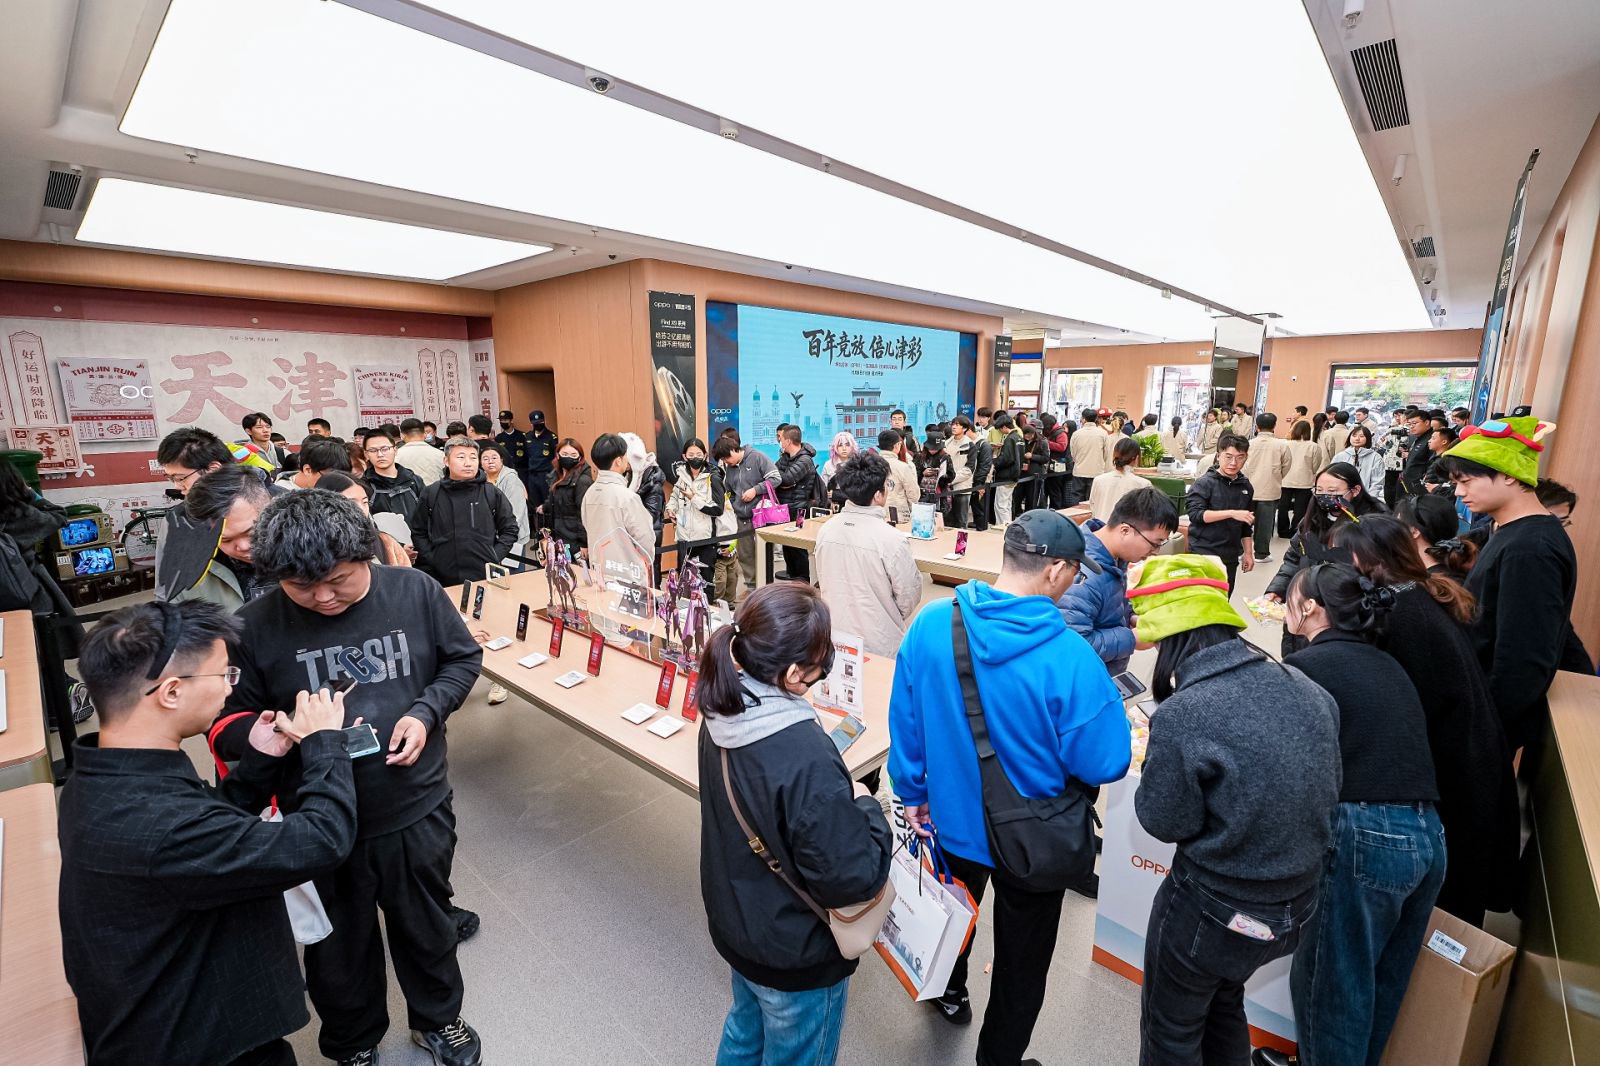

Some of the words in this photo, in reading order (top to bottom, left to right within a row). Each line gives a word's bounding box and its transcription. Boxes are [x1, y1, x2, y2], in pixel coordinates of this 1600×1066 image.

[802, 329, 868, 366] 百年竞放
[21, 349, 48, 421] 好运时刻降临
[71, 366, 111, 377] TIANJIN
[159, 350, 348, 425] 天津
[357, 371, 388, 381] CHINESE
[35, 432, 57, 461] 天津
